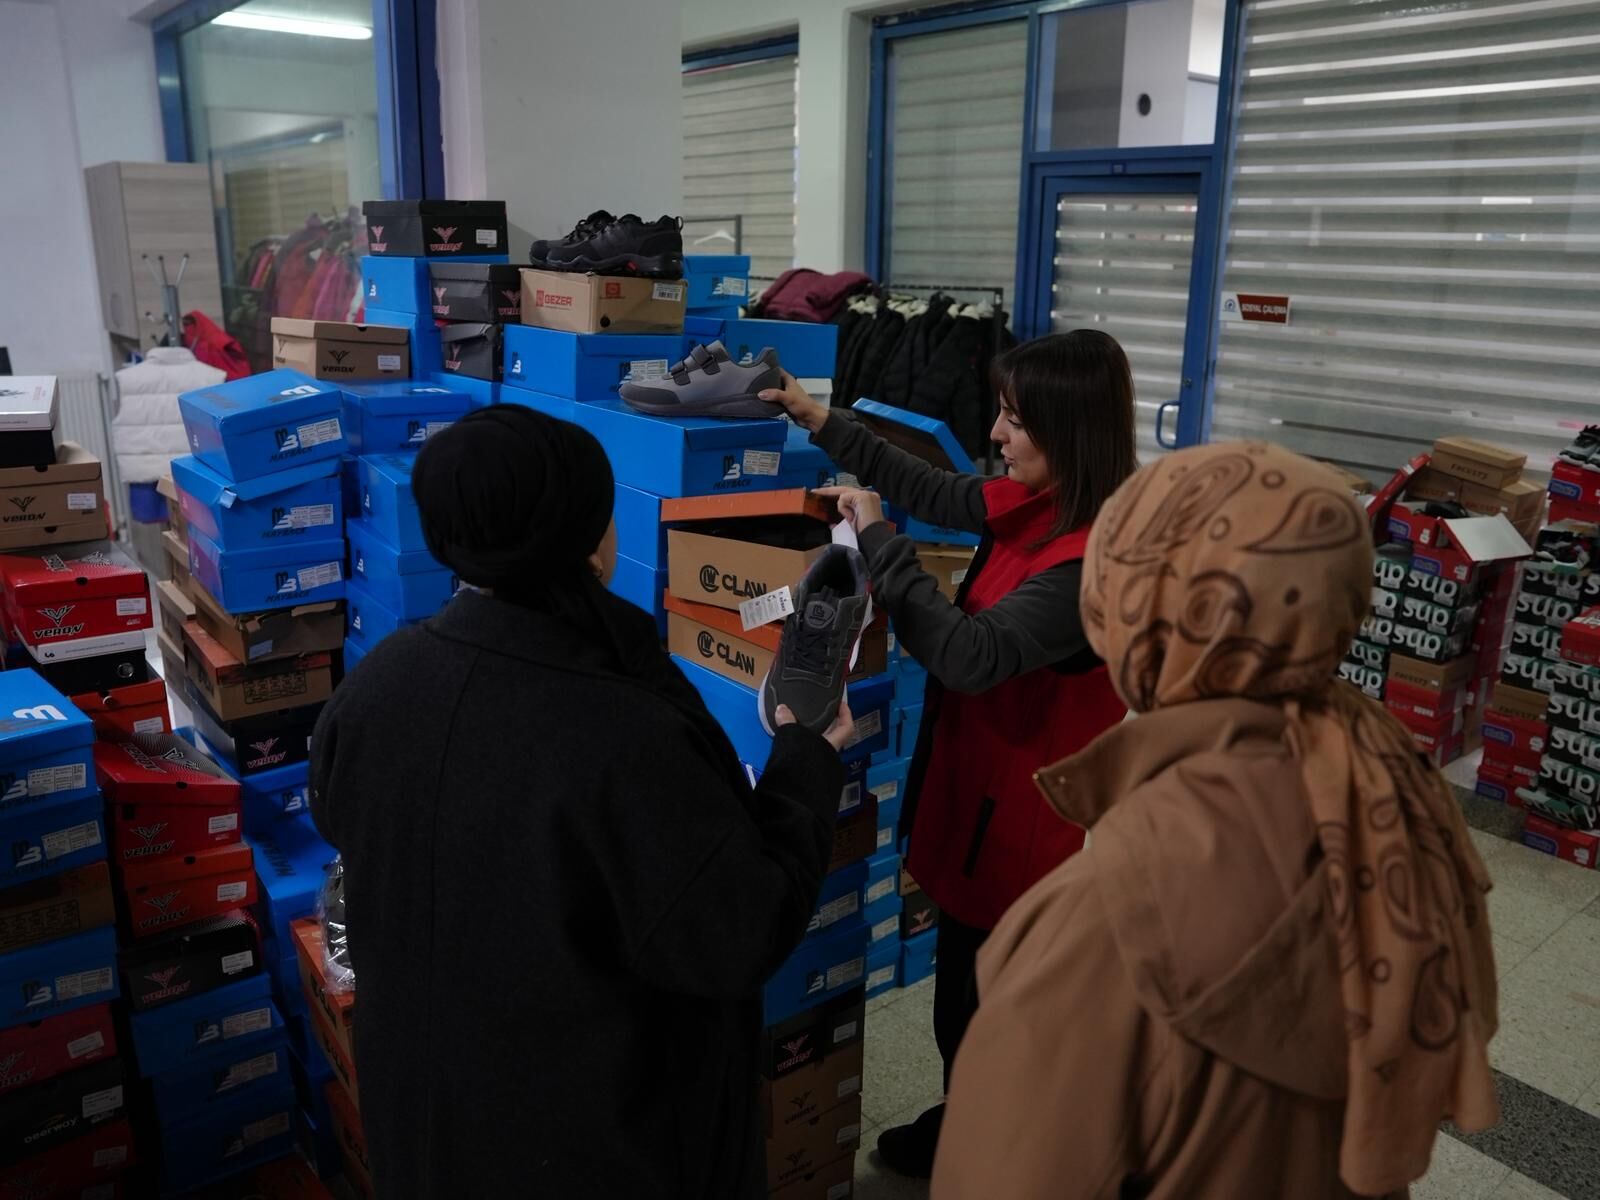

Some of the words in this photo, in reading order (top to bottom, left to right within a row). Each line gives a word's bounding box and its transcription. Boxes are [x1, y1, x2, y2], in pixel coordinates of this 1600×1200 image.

[545, 294, 573, 306] GEZER
[1373, 560, 1404, 584] up
[1407, 570, 1457, 599] sup
[722, 574, 767, 599] CLAW
[1402, 596, 1449, 628] sup
[1516, 594, 1574, 622] sup
[1360, 616, 1393, 638] up
[1392, 623, 1441, 651] sup
[716, 643, 754, 676] CLAW
[1338, 660, 1382, 689] sup
[1539, 754, 1595, 795] sup
